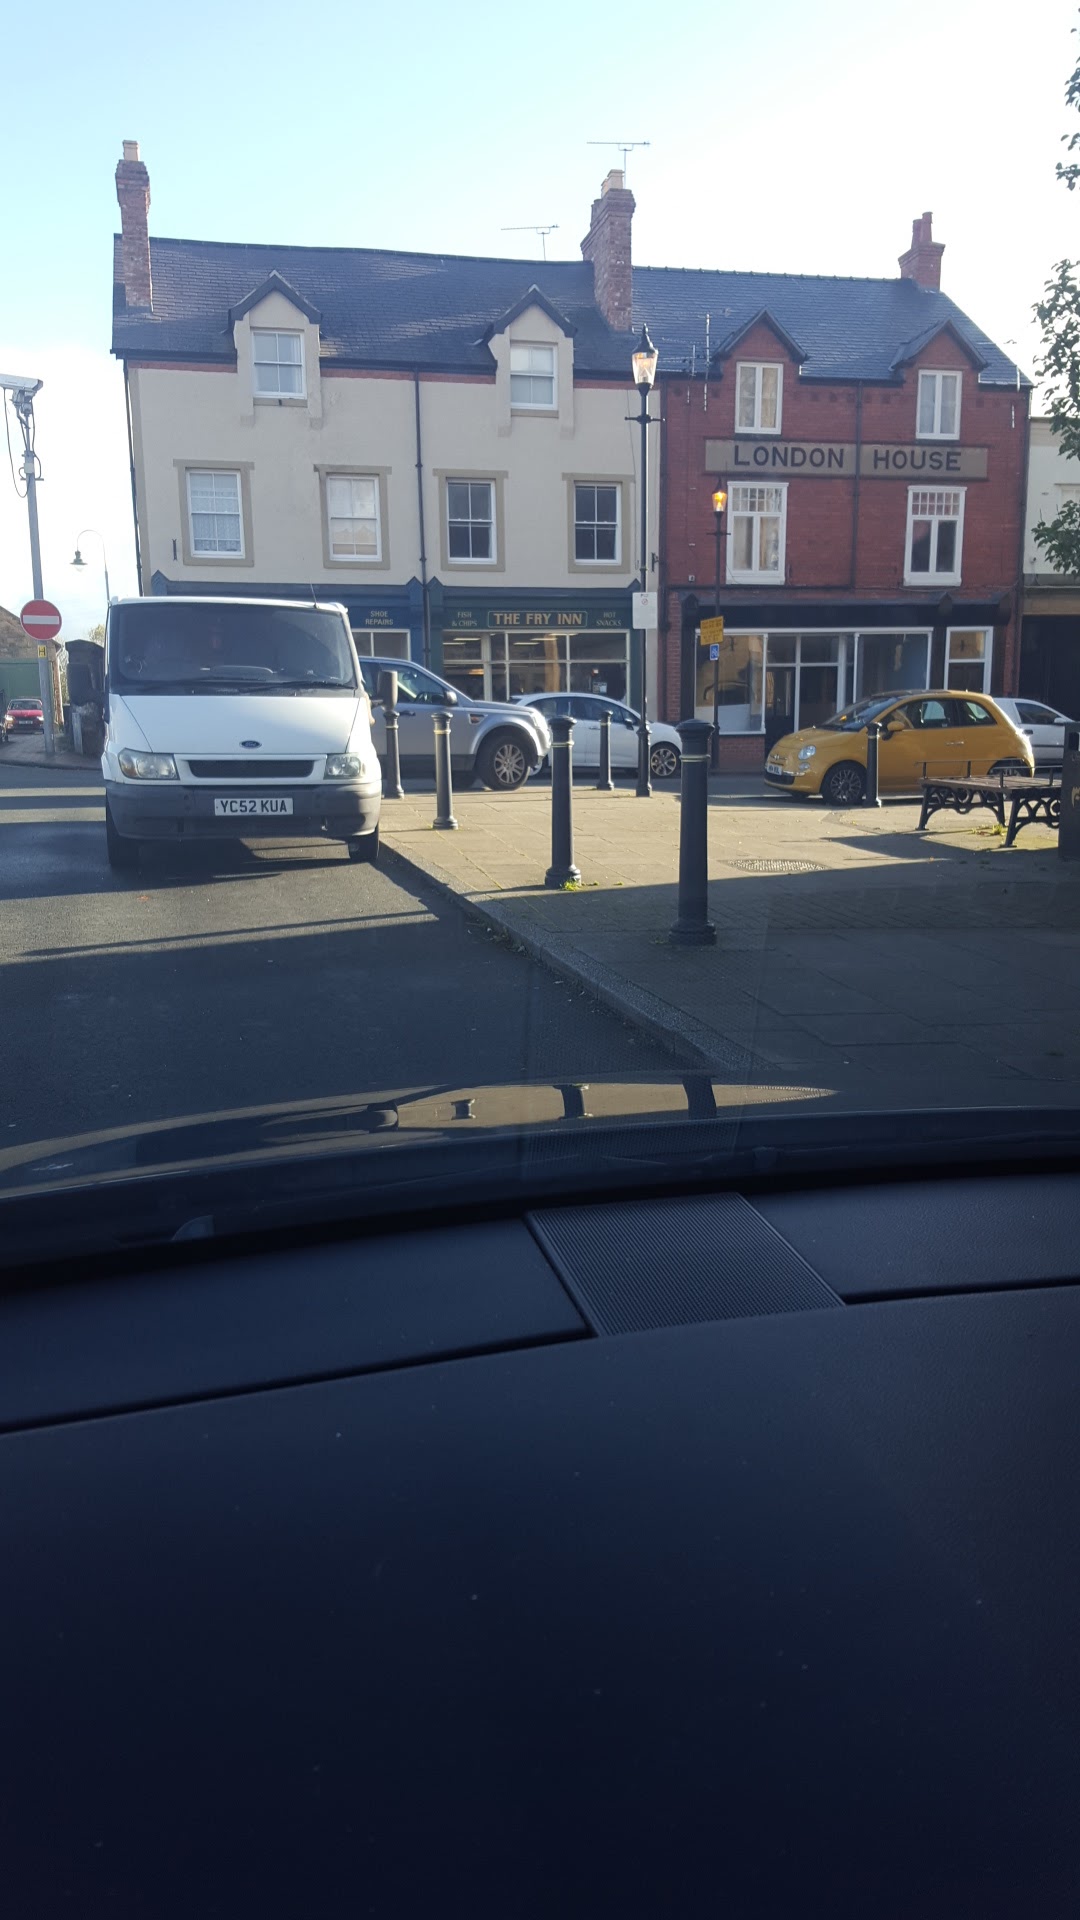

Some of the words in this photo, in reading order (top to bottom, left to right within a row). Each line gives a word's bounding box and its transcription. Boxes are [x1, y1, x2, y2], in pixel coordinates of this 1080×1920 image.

[733, 445, 844, 468] LONDON
[873, 449, 961, 471] HOUSE
[493, 613, 520, 625] THE
[525, 613, 552, 625] FRY
[557, 613, 582, 625] INN
[220, 800, 257, 813] YC52
[260, 800, 287, 813] KUA
